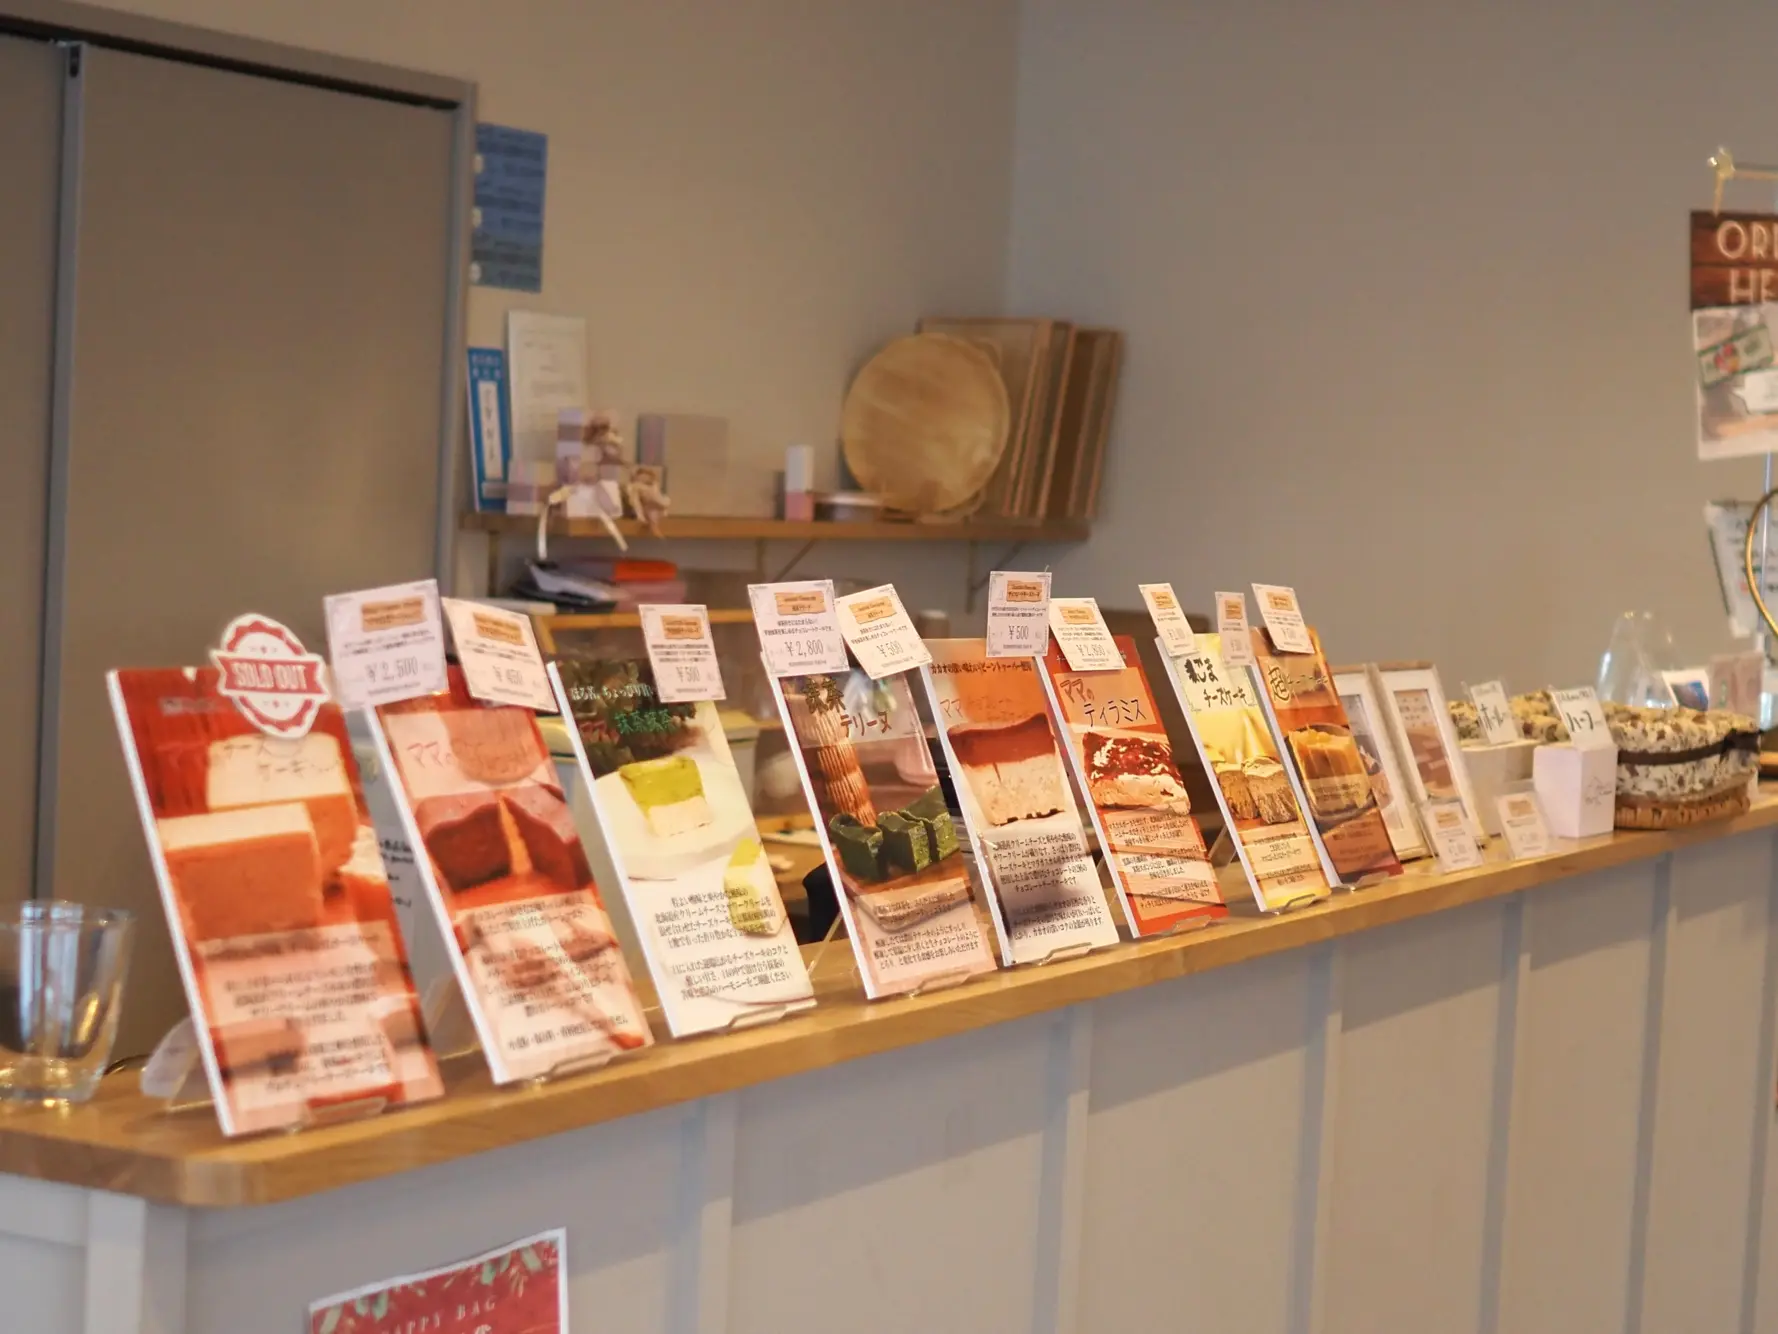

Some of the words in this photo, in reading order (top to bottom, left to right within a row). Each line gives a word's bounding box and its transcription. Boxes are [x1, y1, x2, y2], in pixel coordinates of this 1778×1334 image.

[1717, 220, 1778, 260] OR
[784, 638, 824, 659] ¥2,800
[231, 662, 274, 689] SOLD
[275, 664, 307, 690] OUT
[1060, 679, 1095, 704] ママの
[1204, 686, 1248, 708] チーズケーキ
[840, 710, 892, 738] テリーヌ
[1083, 698, 1147, 729] ティラミス
[381, 1310, 442, 1334] APPY
[457, 1297, 497, 1321] BAG
